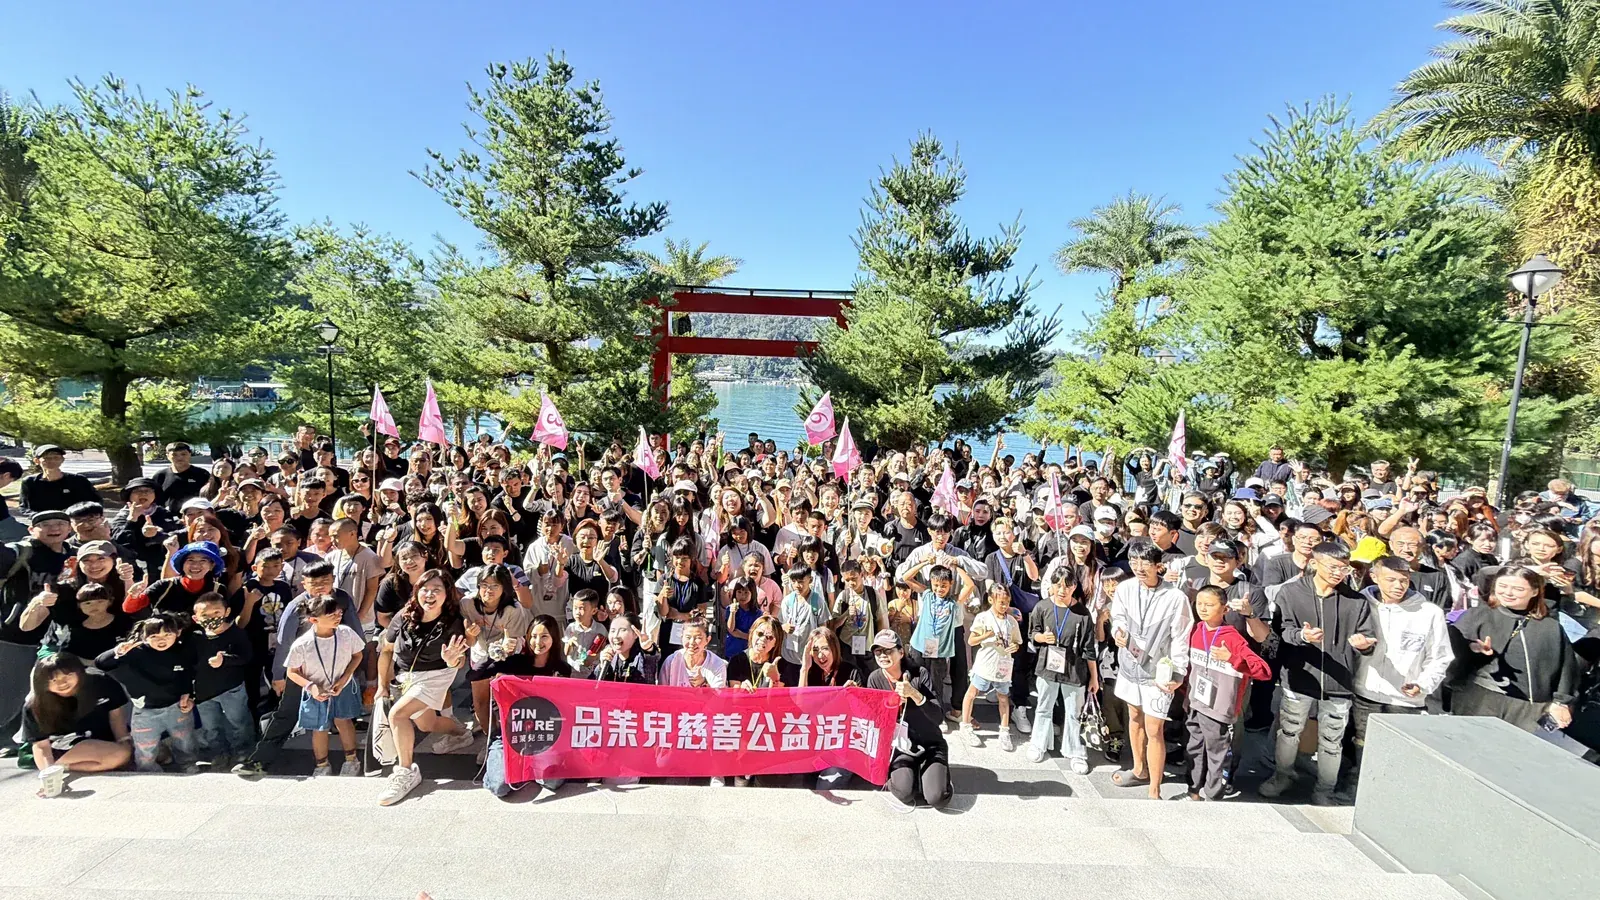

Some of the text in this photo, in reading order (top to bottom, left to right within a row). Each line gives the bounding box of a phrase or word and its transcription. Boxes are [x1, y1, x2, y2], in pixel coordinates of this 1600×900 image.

[511, 708, 537, 720] PIN
[511, 720, 555, 732] MORE
[571, 706, 880, 759] 品茉兒慈善公益活動
